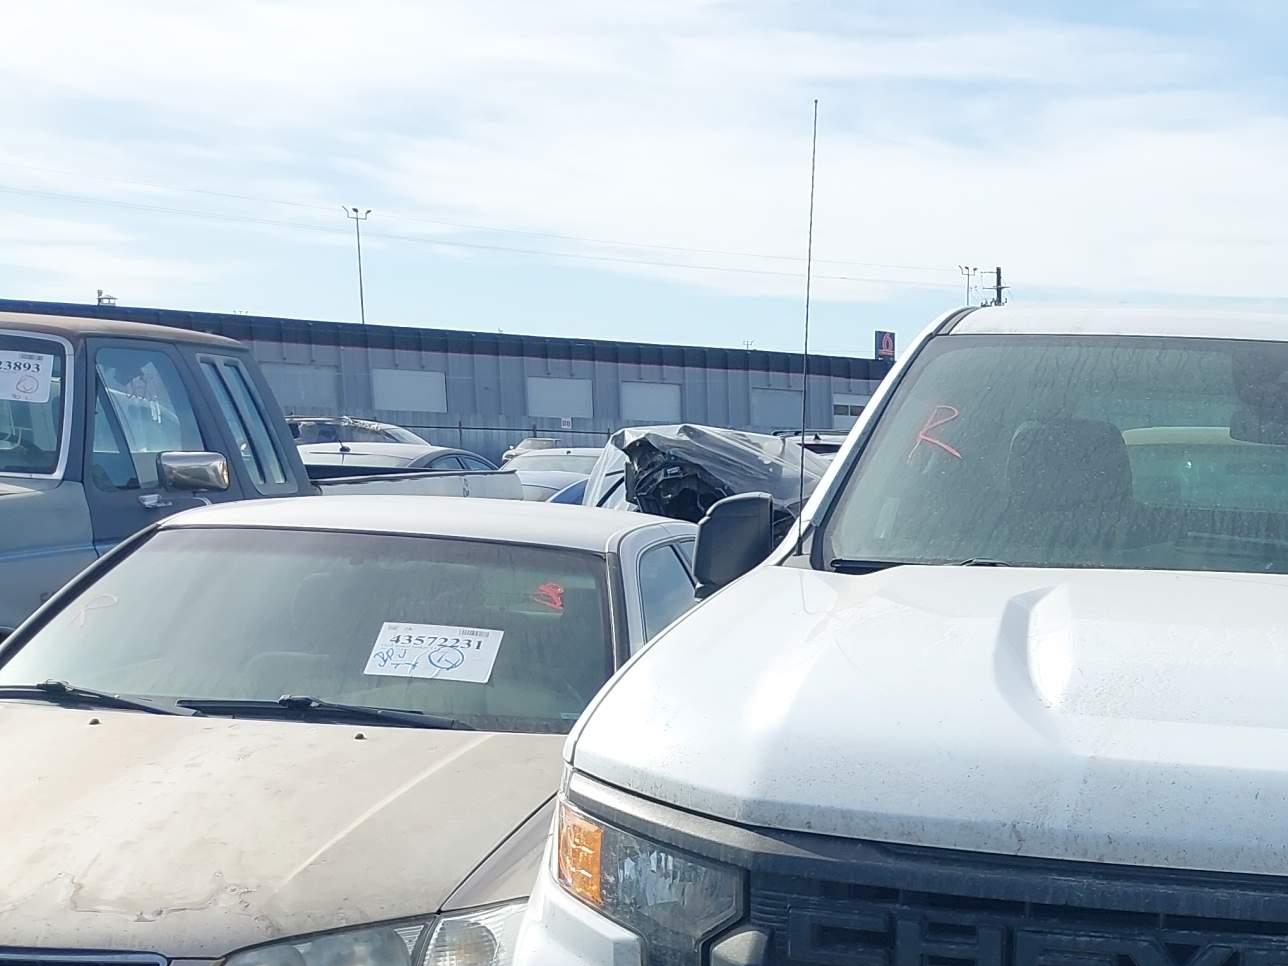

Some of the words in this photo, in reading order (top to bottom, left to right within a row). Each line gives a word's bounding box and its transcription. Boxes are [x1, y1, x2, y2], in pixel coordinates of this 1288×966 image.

[0, 360, 40, 372] 3893
[907, 404, 962, 464] R
[389, 634, 483, 650] 43572231
